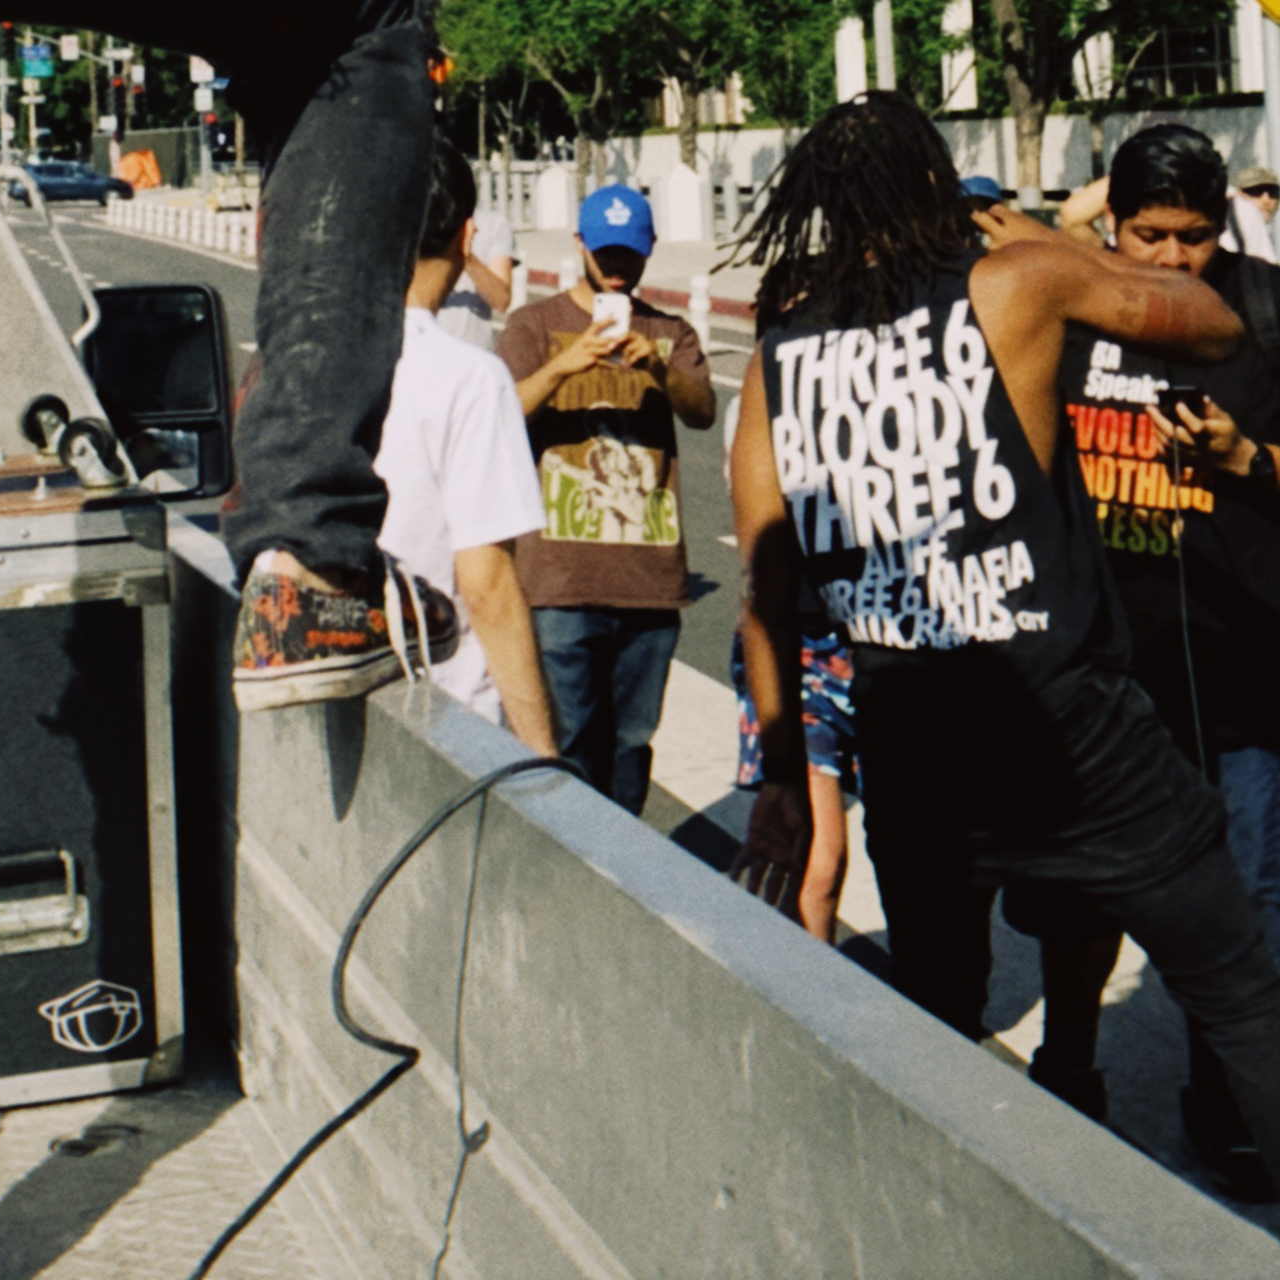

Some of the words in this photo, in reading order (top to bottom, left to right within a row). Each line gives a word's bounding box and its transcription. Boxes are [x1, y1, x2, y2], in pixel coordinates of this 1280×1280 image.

[775, 307, 934, 418] THREE
[943, 298, 987, 378] 6
[773, 367, 994, 494] BLOODY
[787, 445, 966, 557] THREE
[973, 438, 1017, 520] 6
[928, 539, 1035, 610] MAFIA
